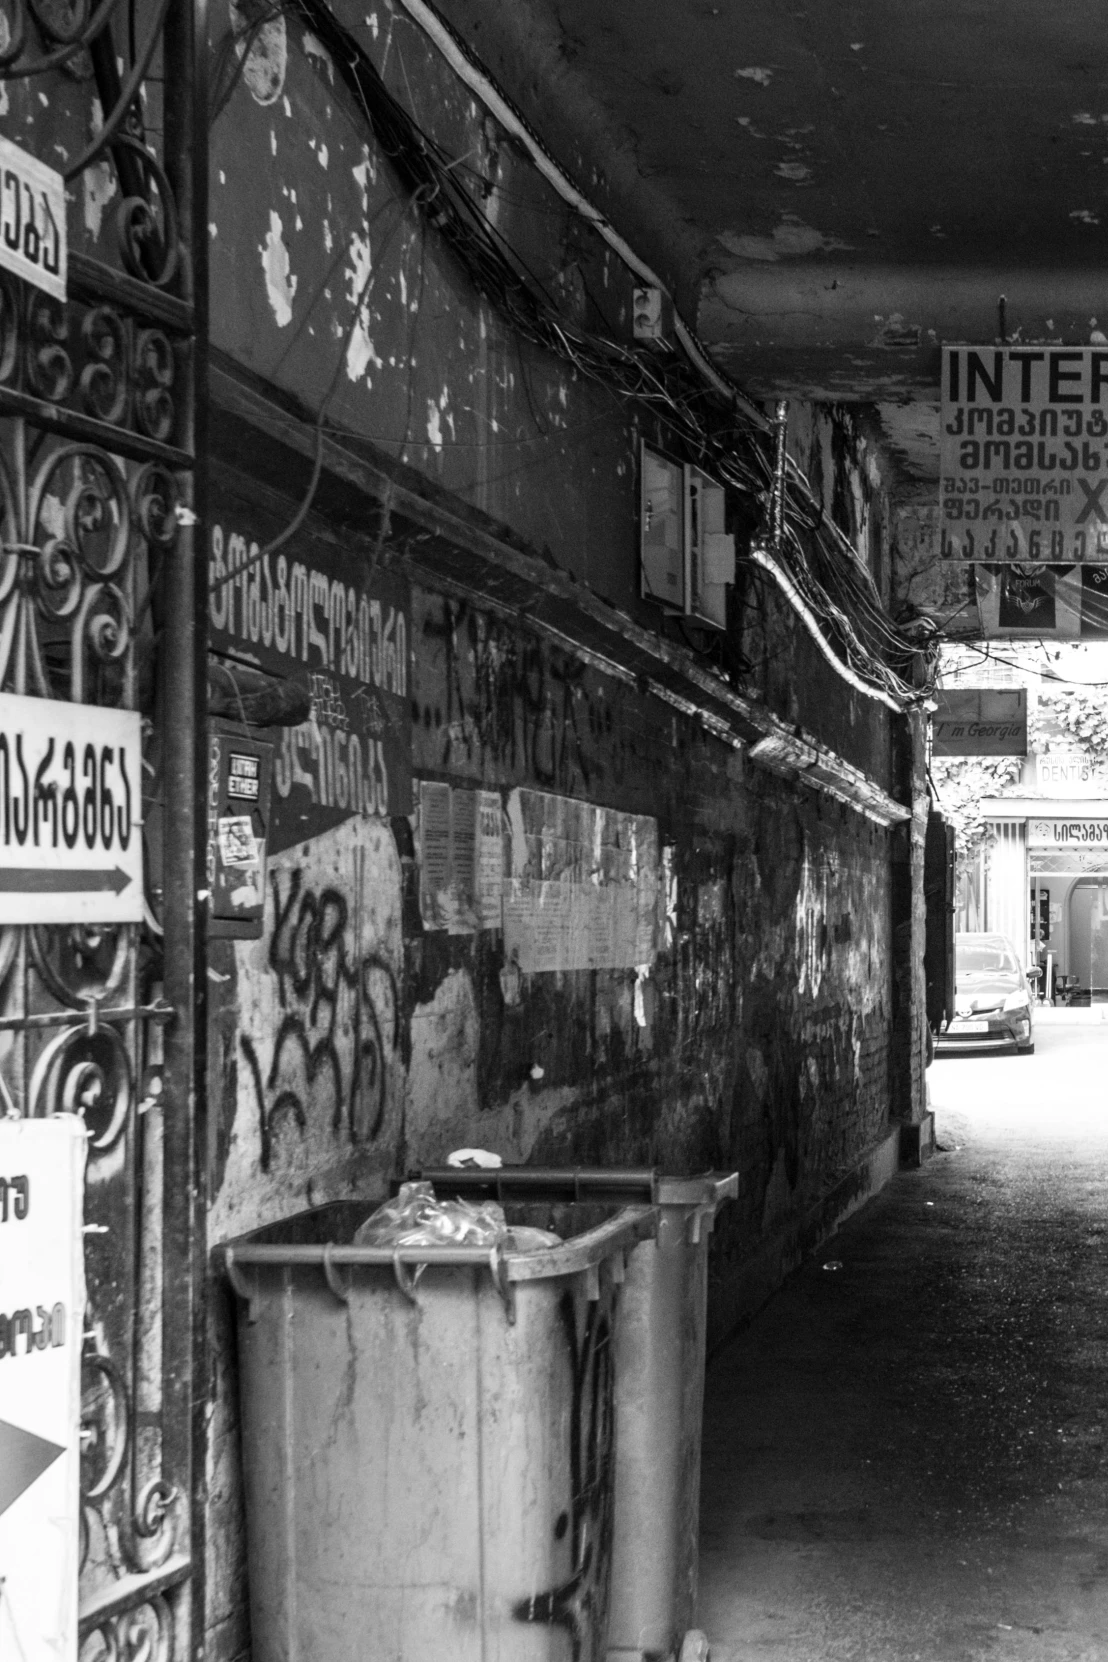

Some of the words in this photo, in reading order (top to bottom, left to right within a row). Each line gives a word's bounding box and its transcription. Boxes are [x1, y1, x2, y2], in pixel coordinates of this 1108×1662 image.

[943, 477, 1071, 496] შავ-თეთრი
[943, 498, 1061, 522] ფერადი
[967, 722, 1022, 741] Georgia
